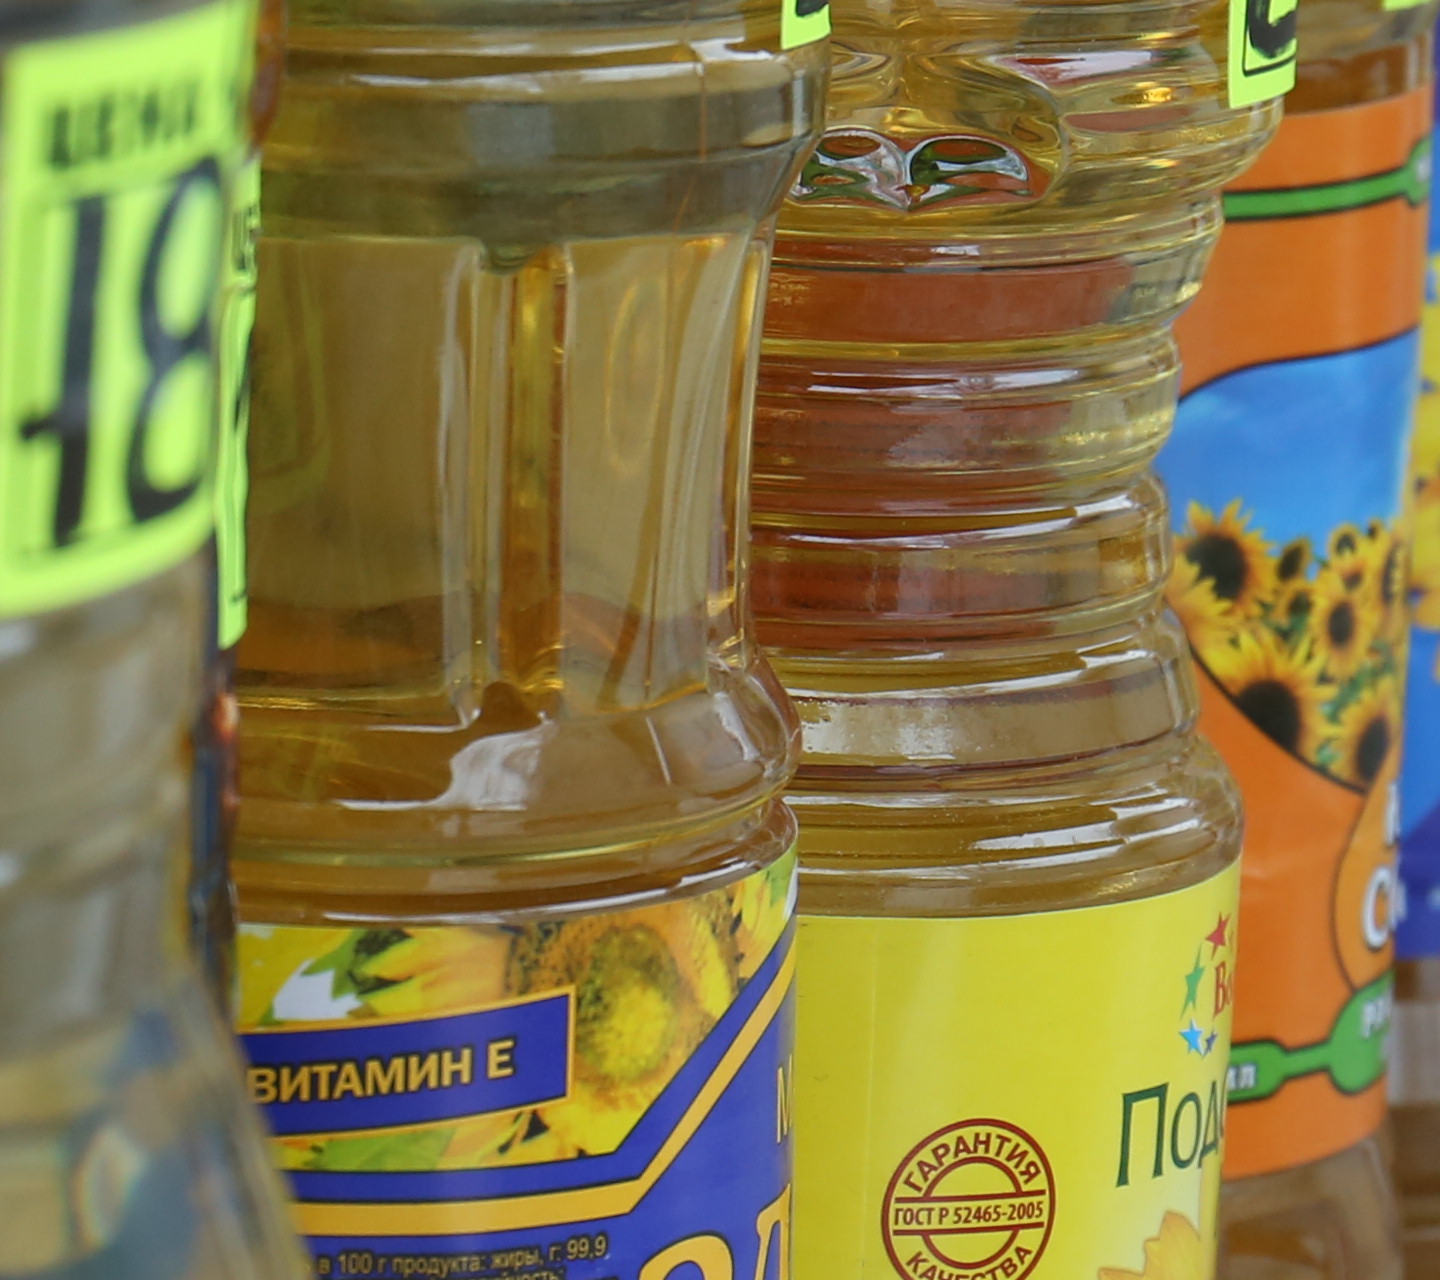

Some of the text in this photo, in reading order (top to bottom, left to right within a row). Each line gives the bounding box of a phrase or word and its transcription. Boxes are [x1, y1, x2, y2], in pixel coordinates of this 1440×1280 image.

[250, 1039, 515, 1105] ВИТАМИН Е
[902, 1131, 1043, 1194] ГАРАНТИЯ
[893, 1206, 935, 1227] ГОСТ
[953, 1199, 1045, 1225] 52465-2005
[338, 1252, 373, 1274] 100
[567, 1235, 608, 1260] 99,9
